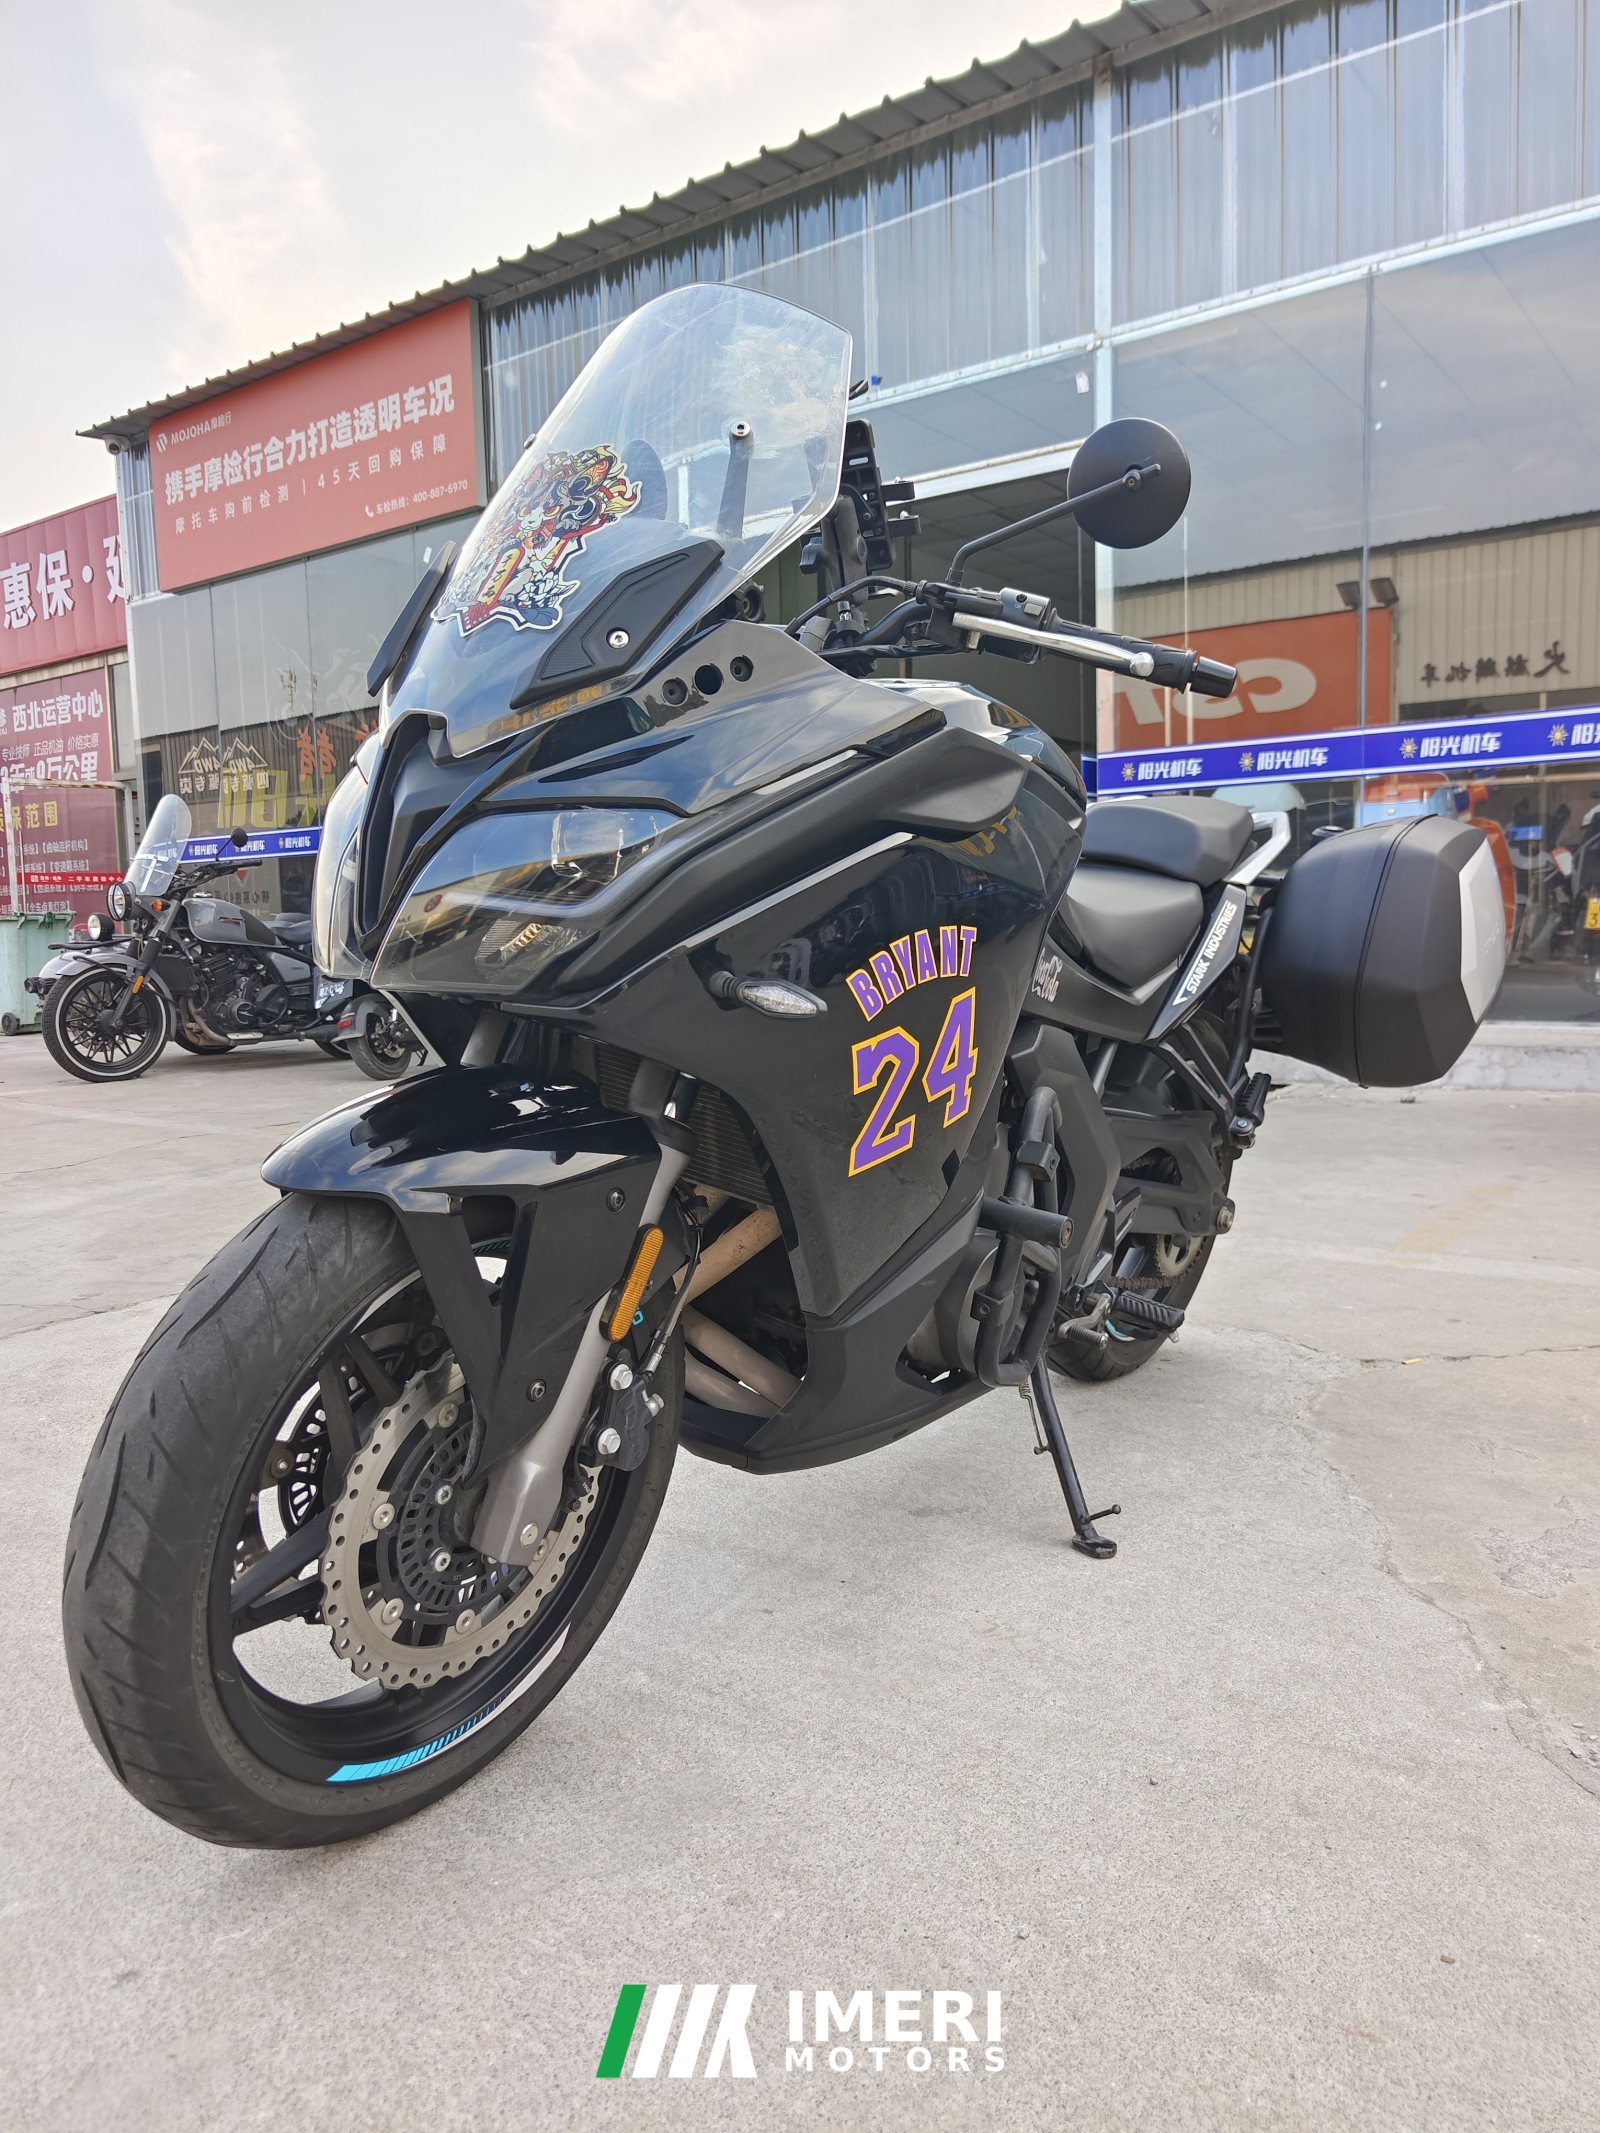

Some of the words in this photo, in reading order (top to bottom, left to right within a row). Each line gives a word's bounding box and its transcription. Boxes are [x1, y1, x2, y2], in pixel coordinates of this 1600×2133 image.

[165, 374, 455, 506] 携手摩检行合力打造透明车况
[12, 688, 104, 733] 西北运营中心
[1420, 730, 1503, 759] 阳光机车
[1137, 757, 1203, 780] 阳光机车
[1256, 746, 1329, 771] 阳光机车
[846, 925, 978, 1022] BRYANT
[1186, 961, 1210, 994] STARK
[1203, 901, 1238, 960] INDUSTRIES
[848, 986, 979, 1178] 24
